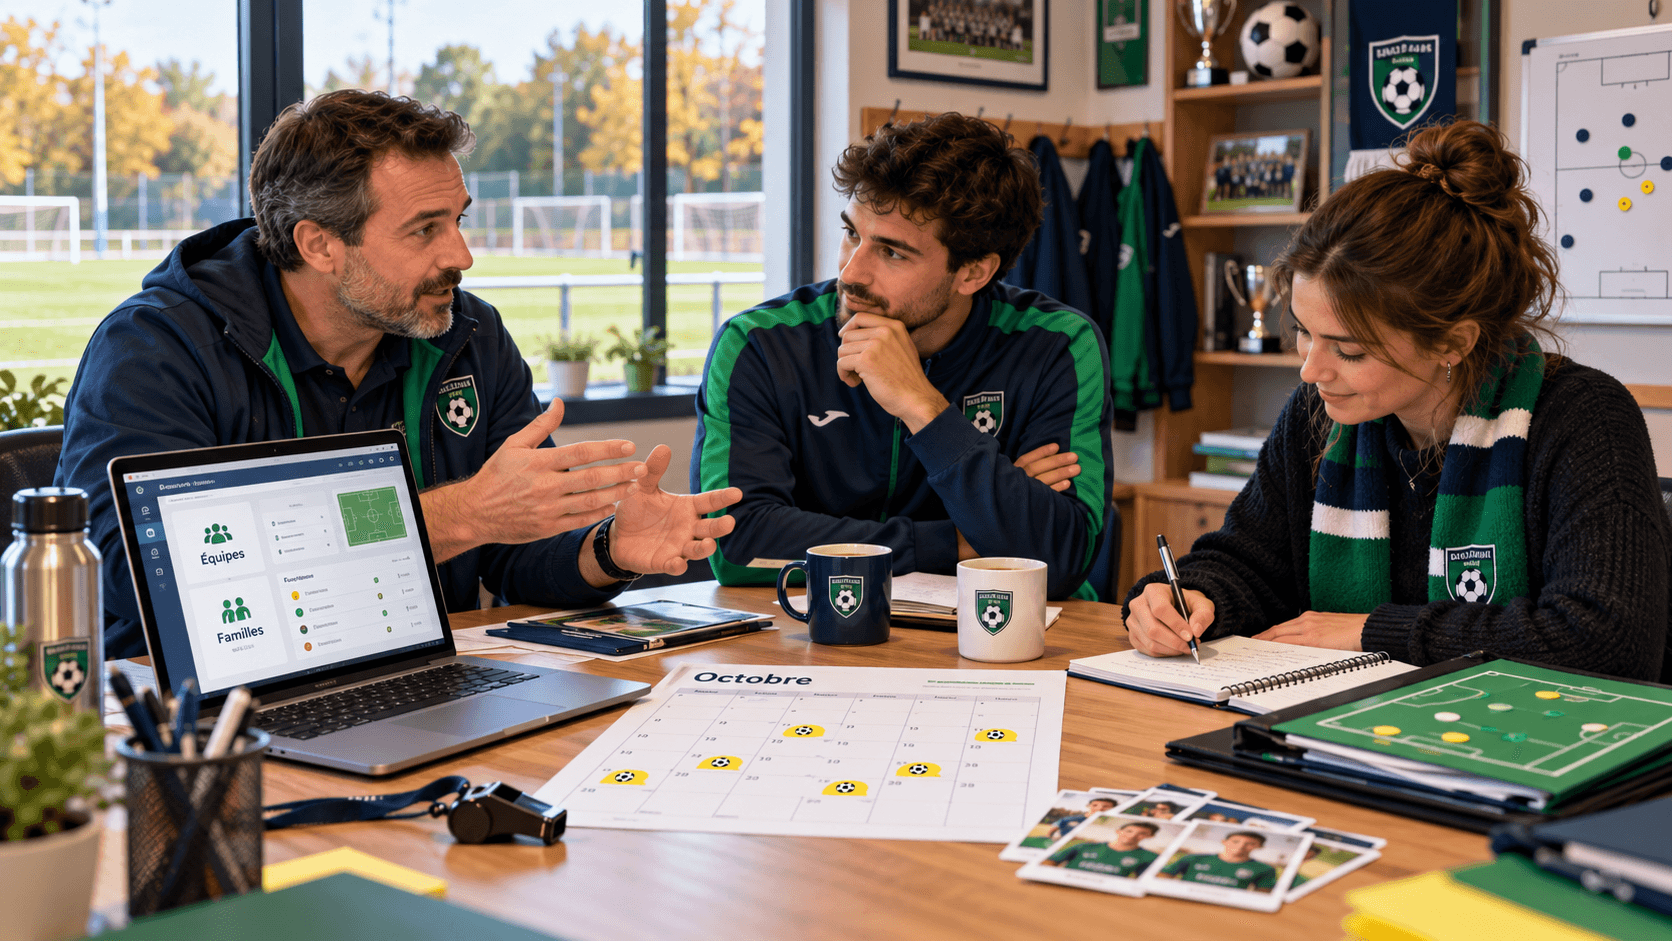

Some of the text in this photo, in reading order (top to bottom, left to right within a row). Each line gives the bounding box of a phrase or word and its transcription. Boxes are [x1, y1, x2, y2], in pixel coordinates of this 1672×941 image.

[200, 549, 245, 566] Équipes
[216, 626, 264, 644] Familles
[694, 672, 812, 686] Octobre
